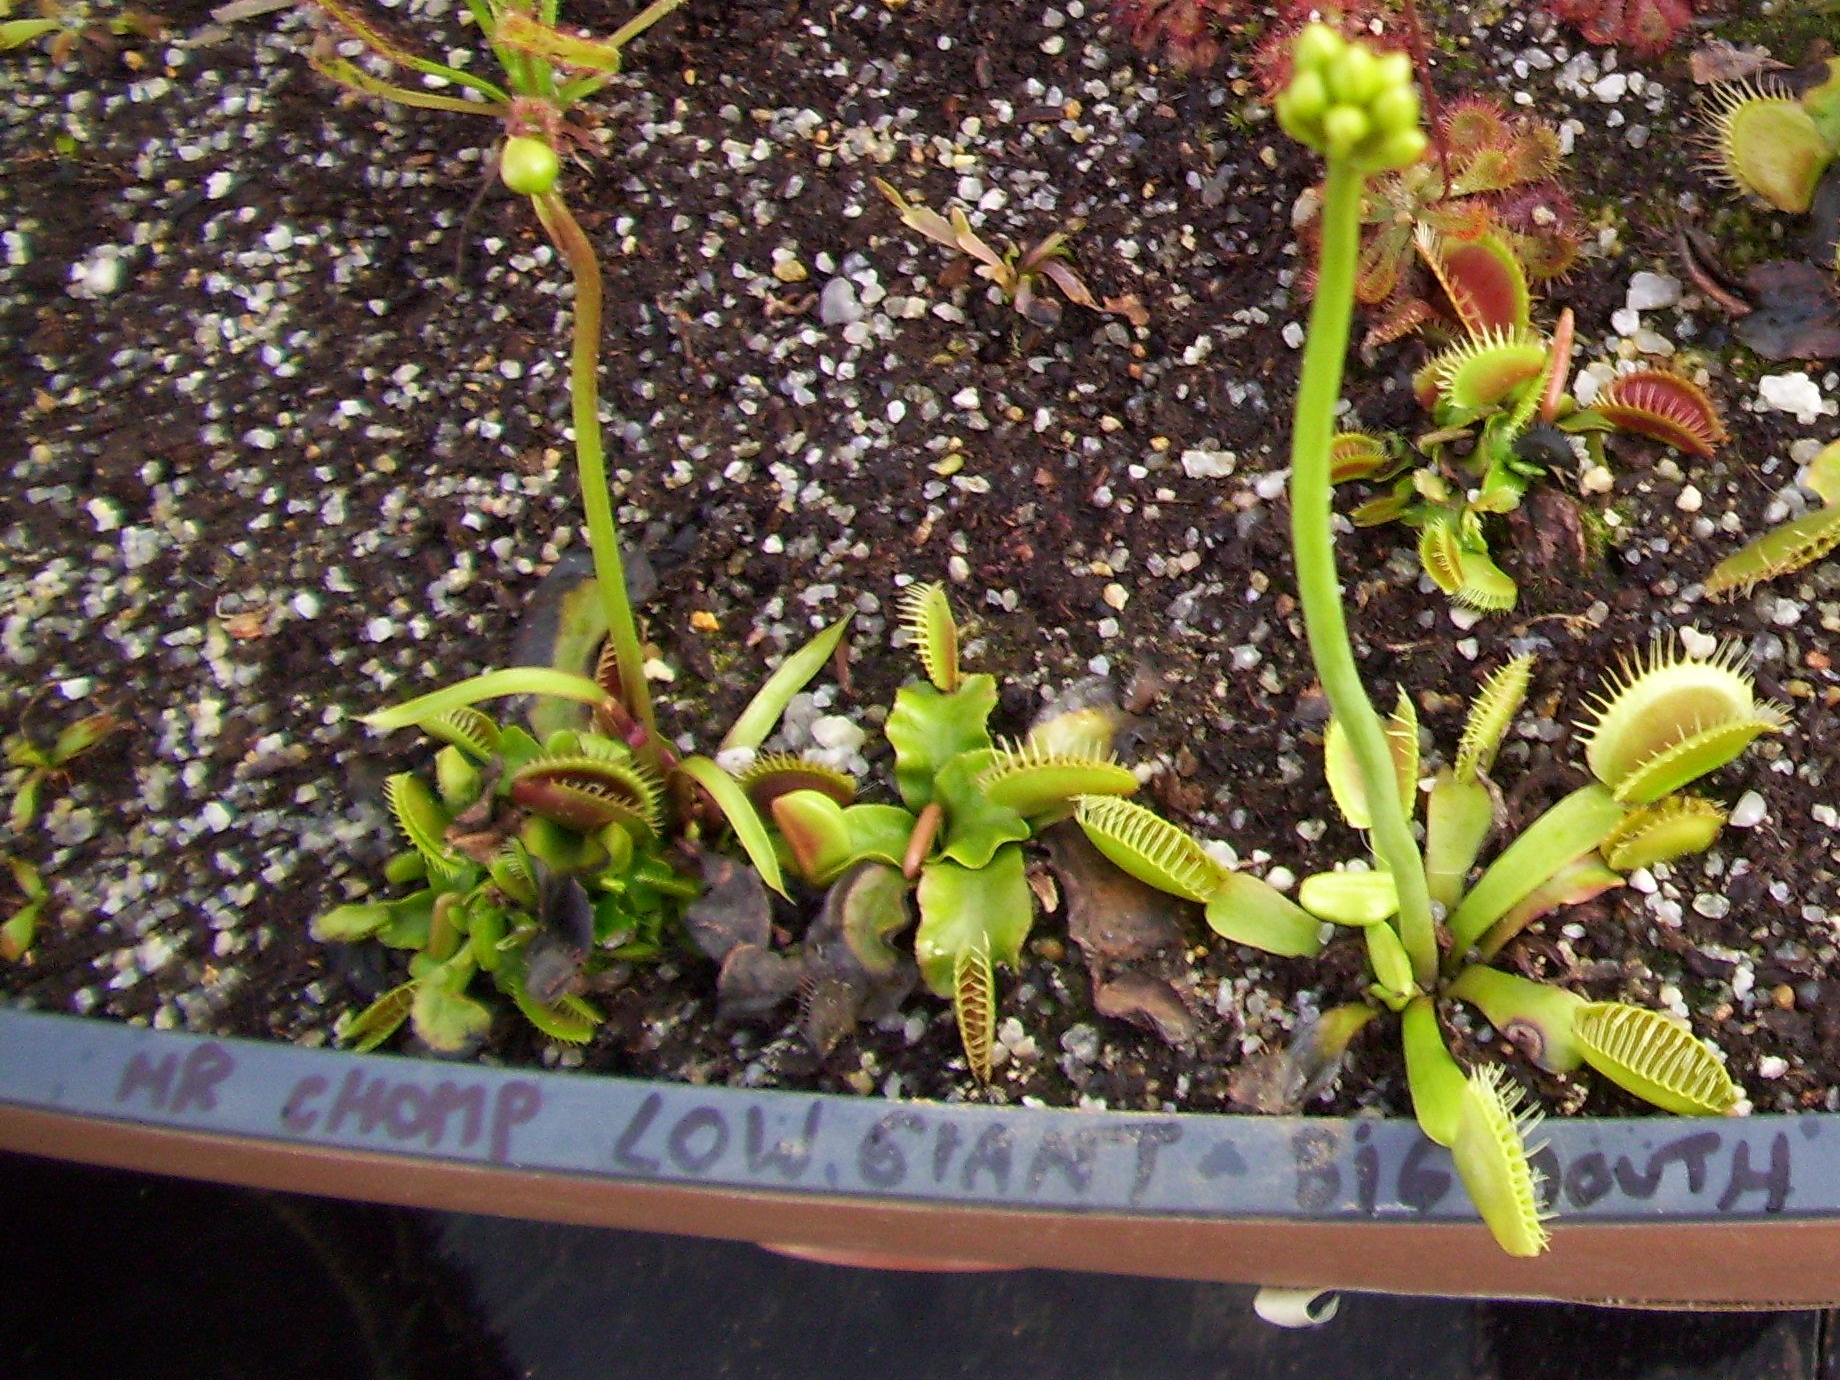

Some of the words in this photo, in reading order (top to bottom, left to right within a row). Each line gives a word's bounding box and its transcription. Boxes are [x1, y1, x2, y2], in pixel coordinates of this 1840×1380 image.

[115, 1041, 236, 1114] MR
[281, 1067, 542, 1163] CHOMP
[856, 1109, 1183, 1204] GIANT
